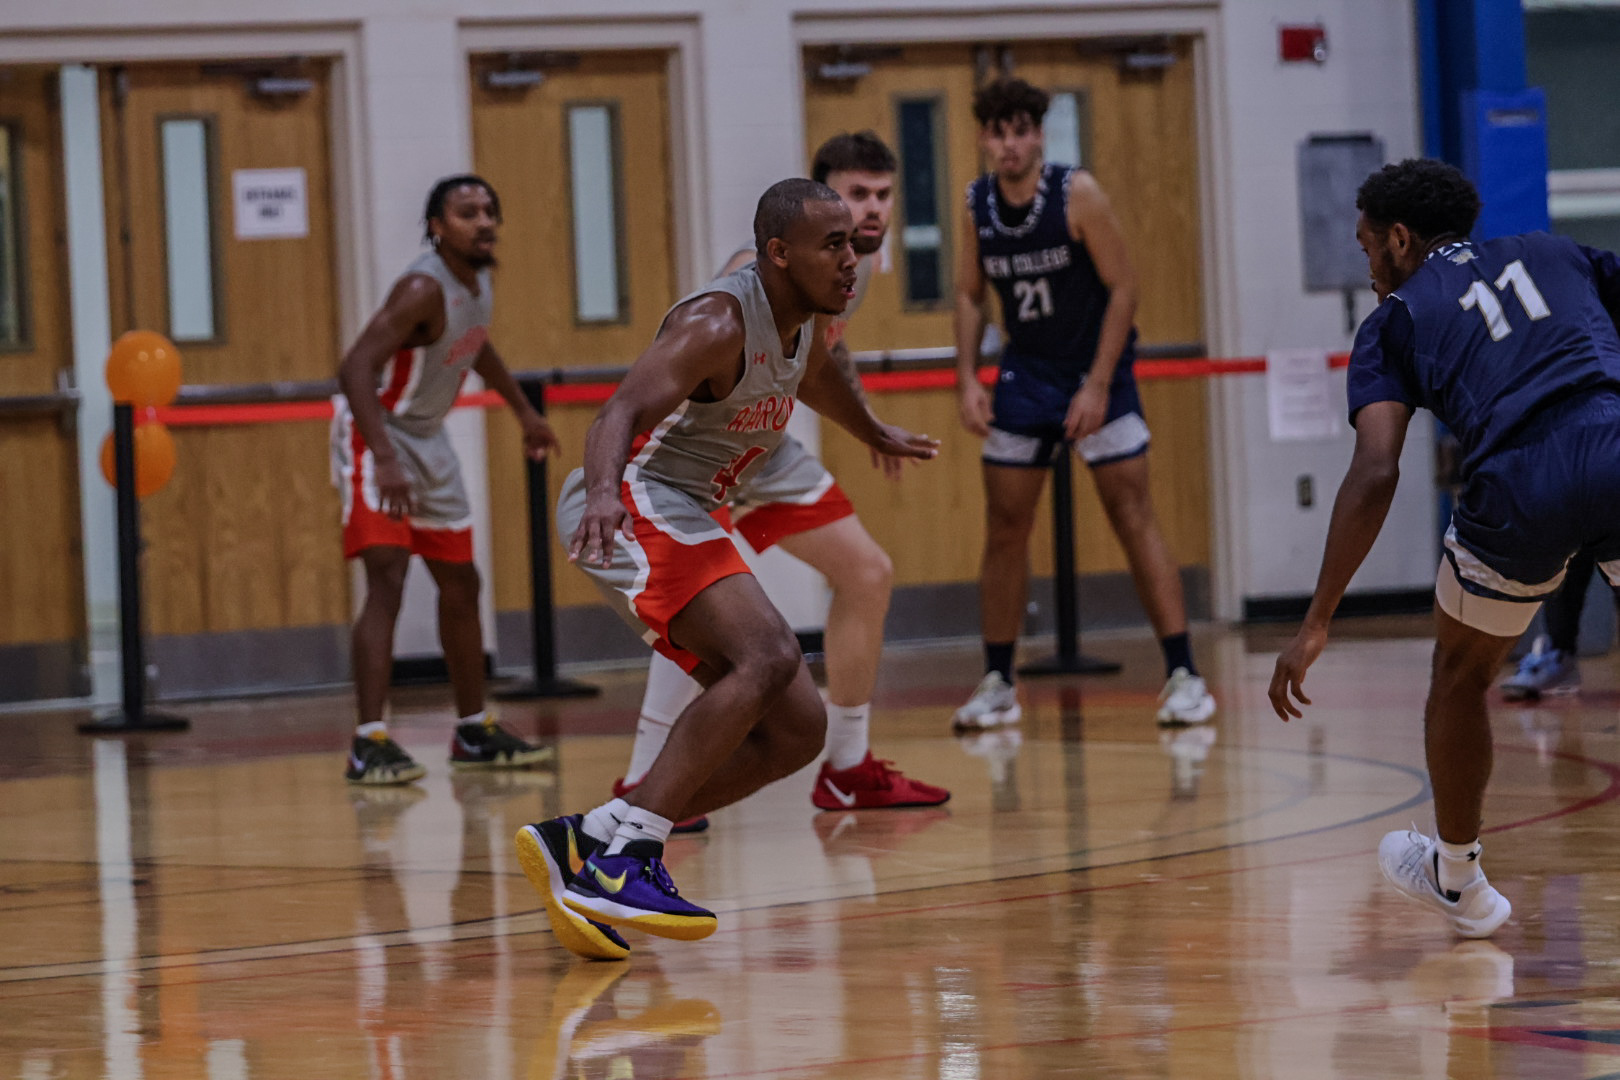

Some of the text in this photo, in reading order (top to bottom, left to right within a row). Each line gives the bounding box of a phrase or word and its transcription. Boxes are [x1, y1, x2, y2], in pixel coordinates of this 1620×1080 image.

[1011, 244, 1070, 276] COLLEGE
[1012, 278, 1055, 322] 21
[1458, 259, 1551, 341] 11
